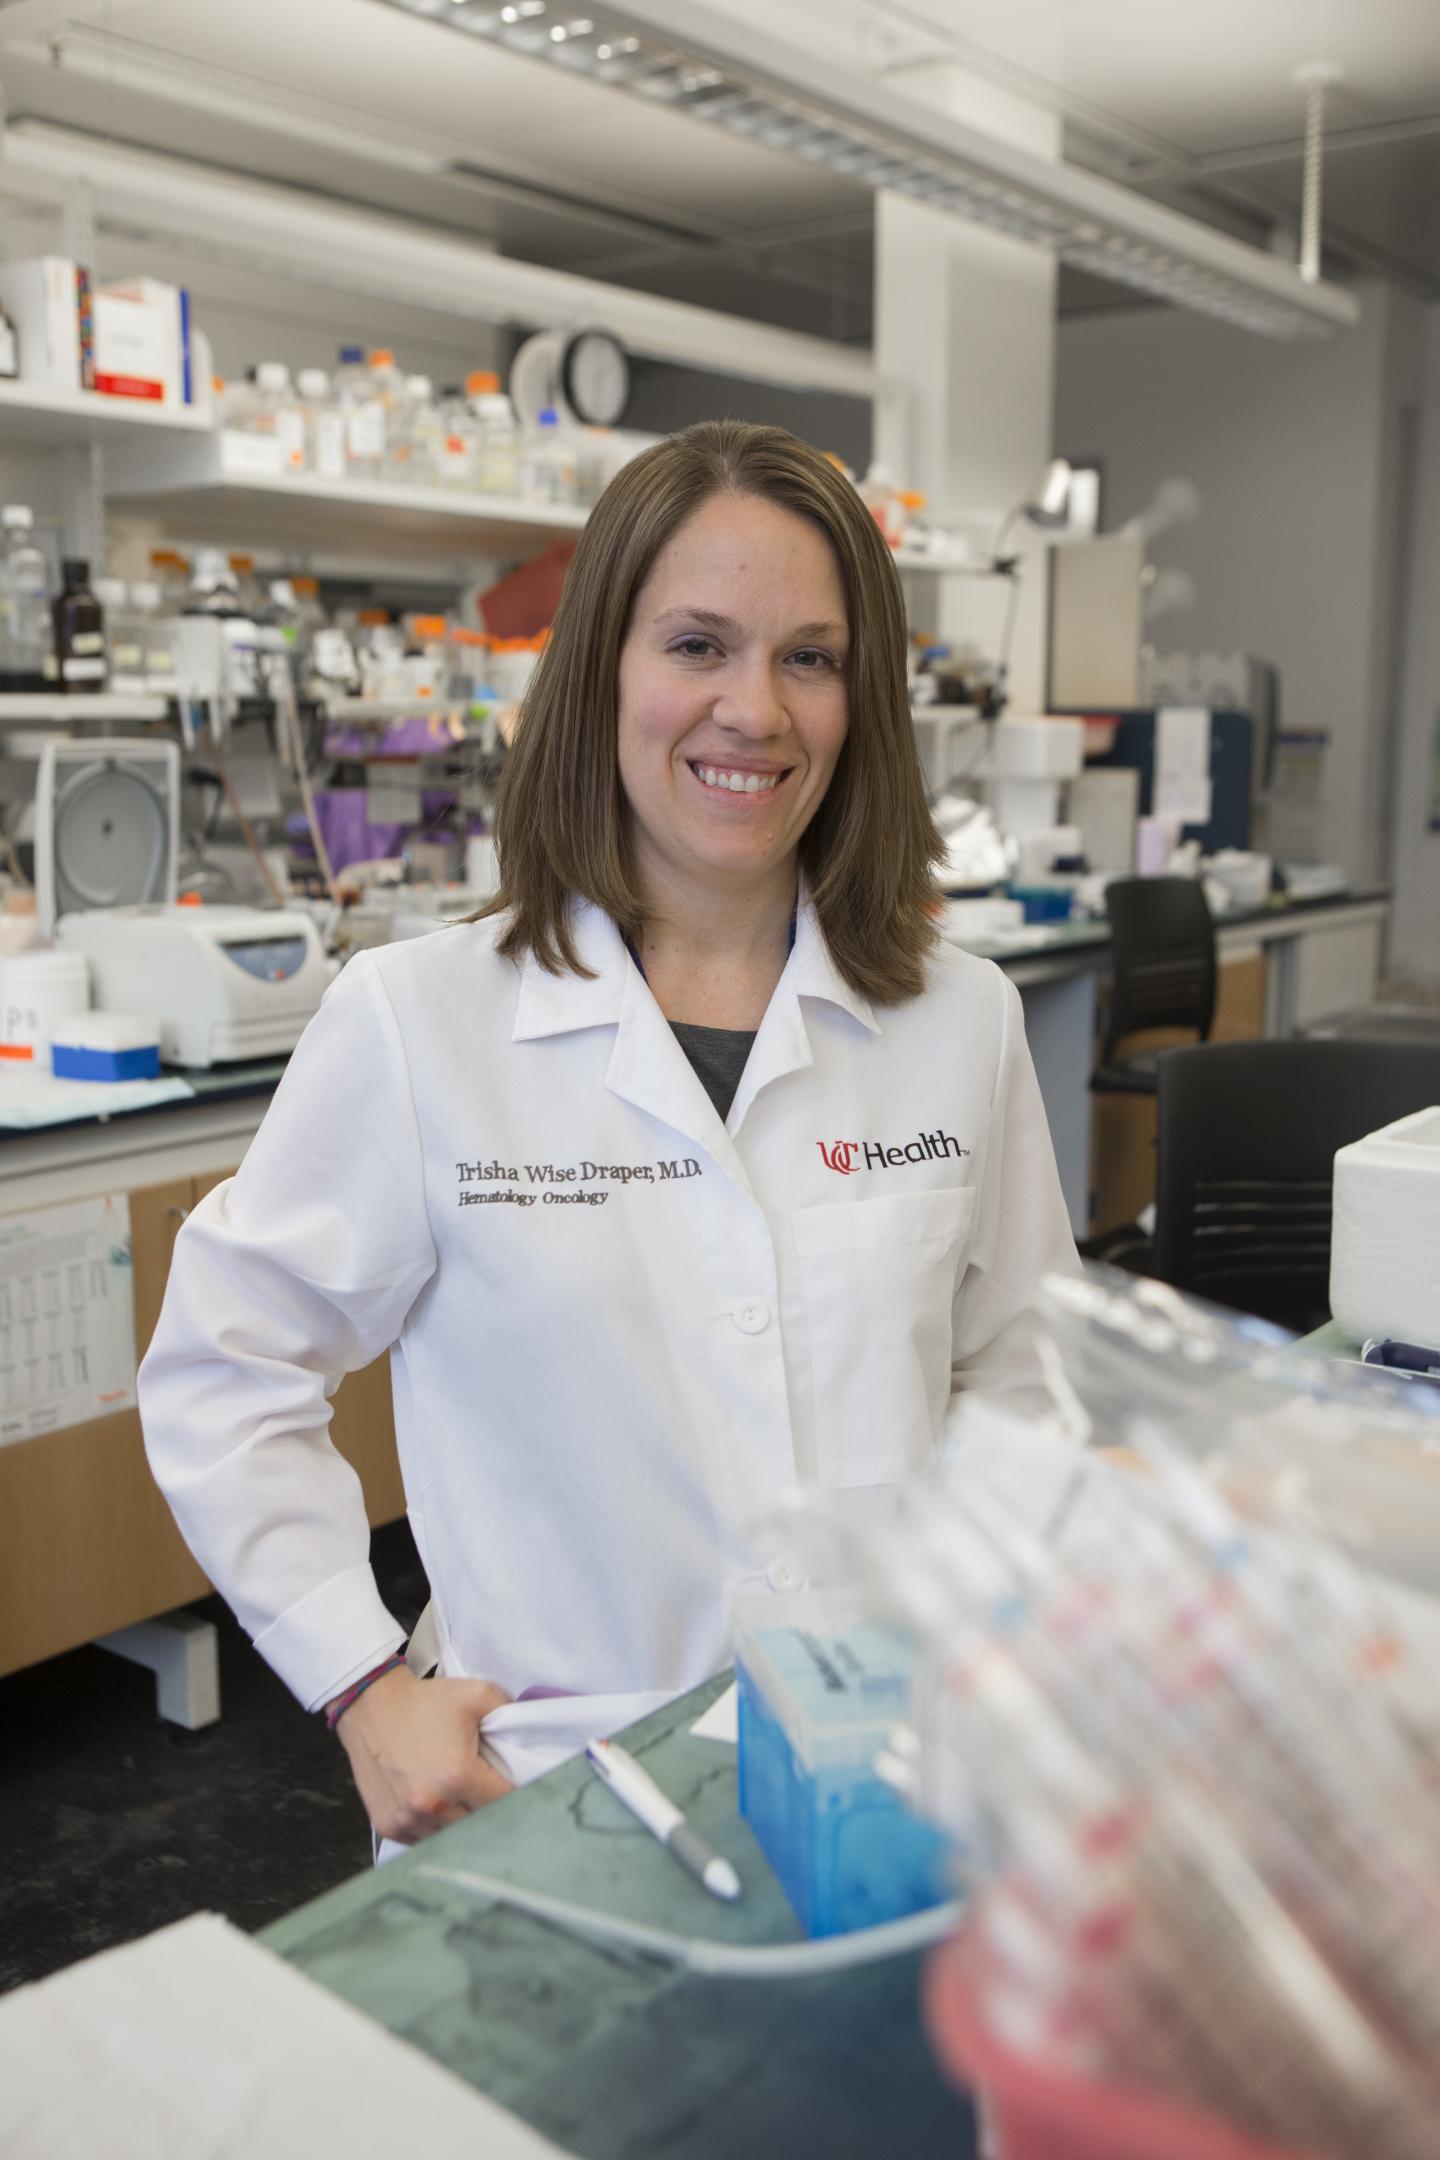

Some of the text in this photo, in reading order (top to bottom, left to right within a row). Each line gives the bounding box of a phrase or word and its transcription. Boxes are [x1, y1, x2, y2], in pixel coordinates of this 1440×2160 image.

[816, 1140, 860, 1175] UC
[863, 1130, 961, 1170] Health
[456, 1160, 519, 1183] Trisha
[524, 1164, 577, 1183] Wise
[579, 1161, 656, 1184] Draper,
[458, 1190, 609, 1206] Hematology Oncology
